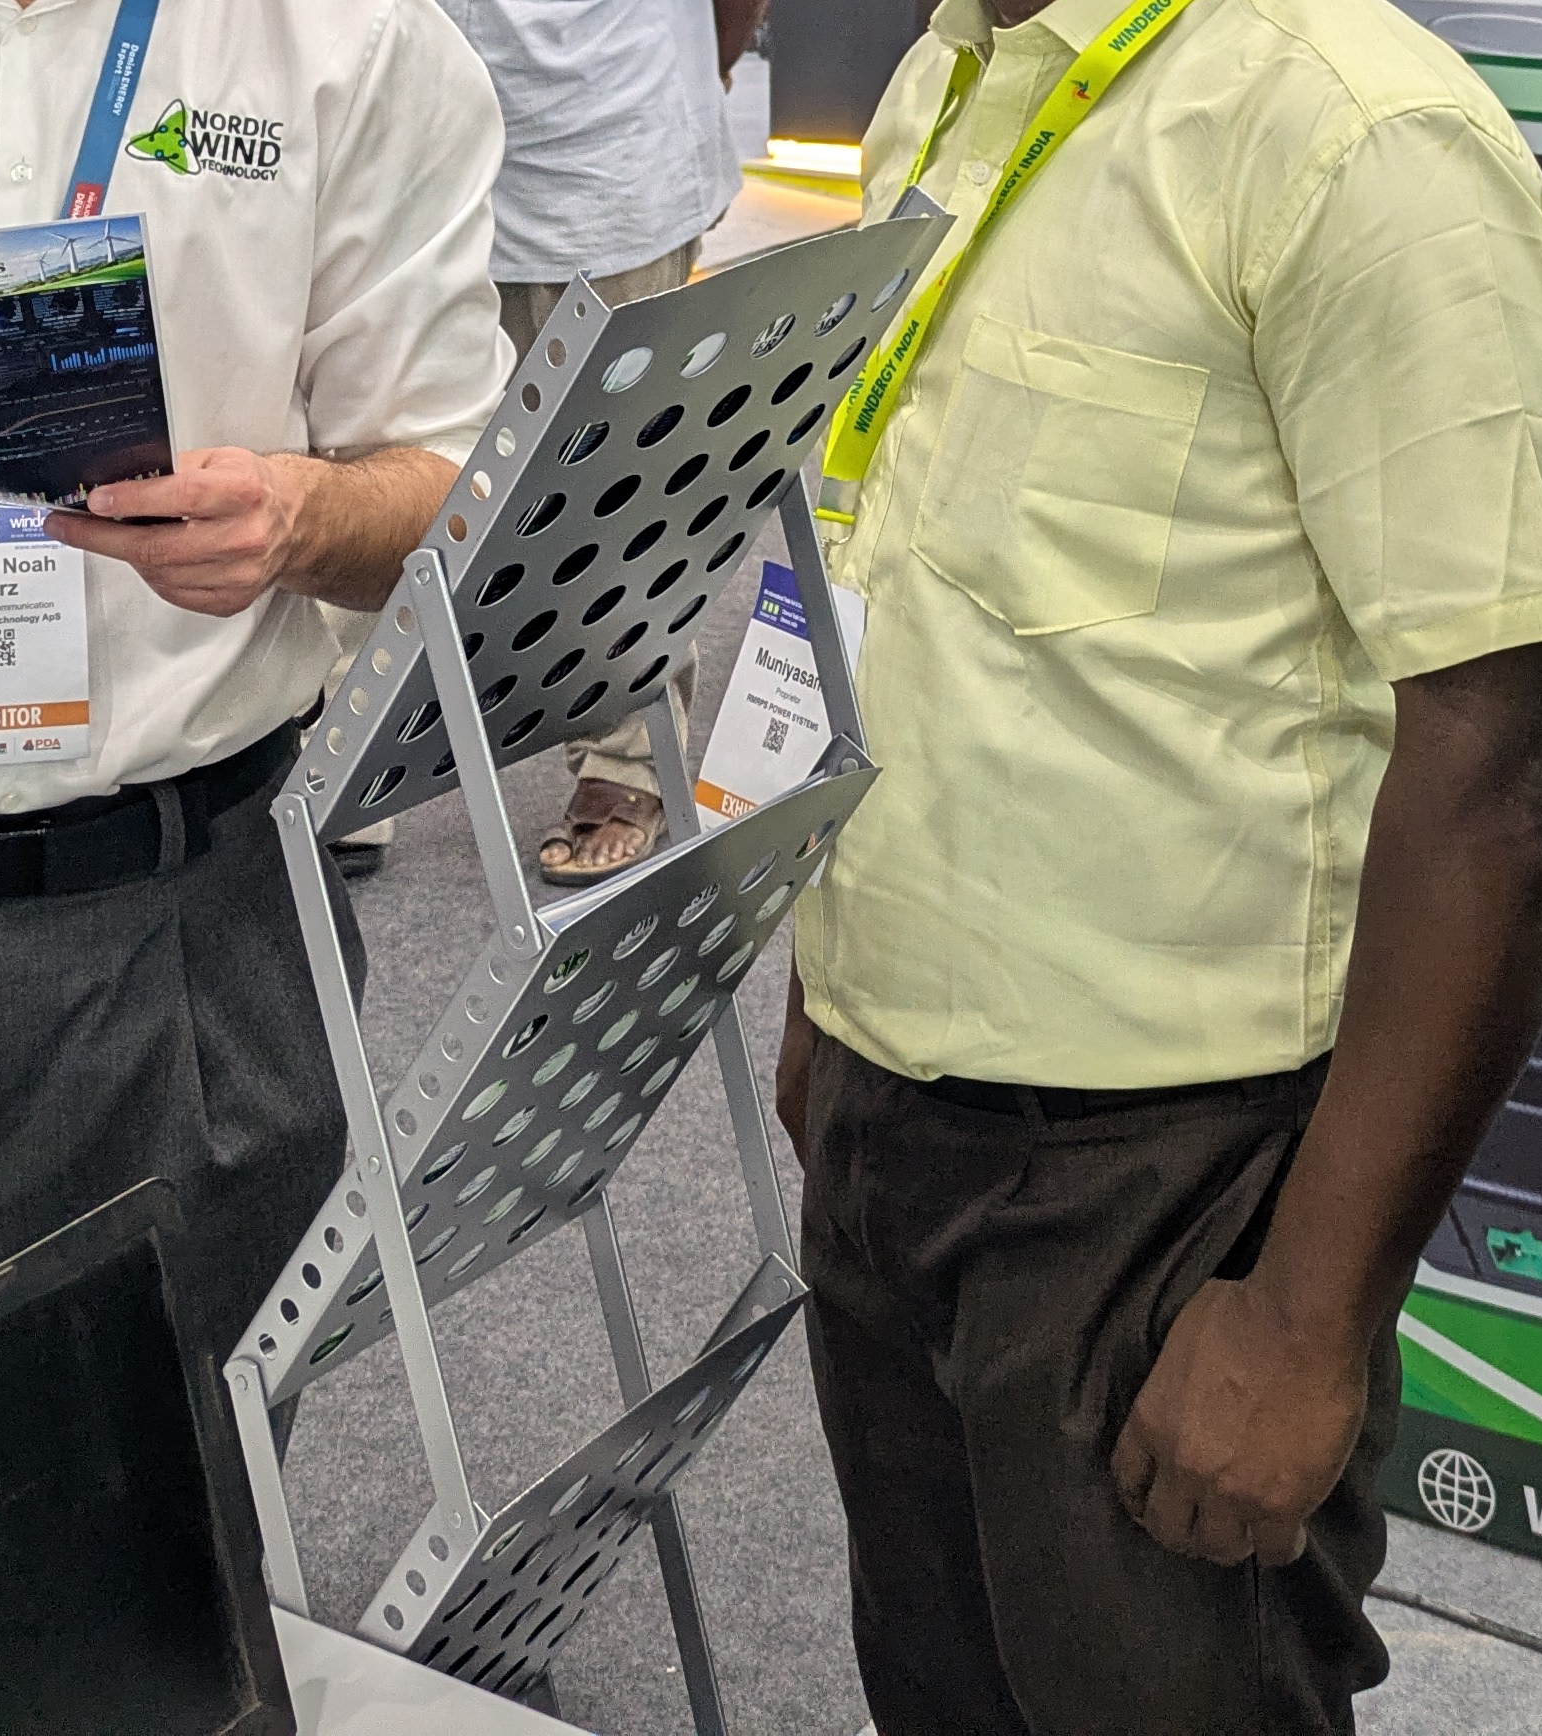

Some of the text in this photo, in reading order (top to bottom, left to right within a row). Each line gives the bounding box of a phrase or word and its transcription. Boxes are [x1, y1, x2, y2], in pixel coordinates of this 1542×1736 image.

[113, 41, 131, 75] Export
[191, 109, 284, 142] NORDIC
[190, 131, 281, 167] WIND
[1019, 130, 1056, 170] INDIA
[200, 158, 278, 182] TECHNOLOGY
[853, 357, 897, 435] WINDERGY
[893, 318, 921, 363] INDIA
[2, 555, 57, 575] Noah
[775, 686, 802, 705] Proprietor
[746, 692, 819, 733] RMRPS POWER SYSTEMS
[721, 793, 754, 820] EXHI
